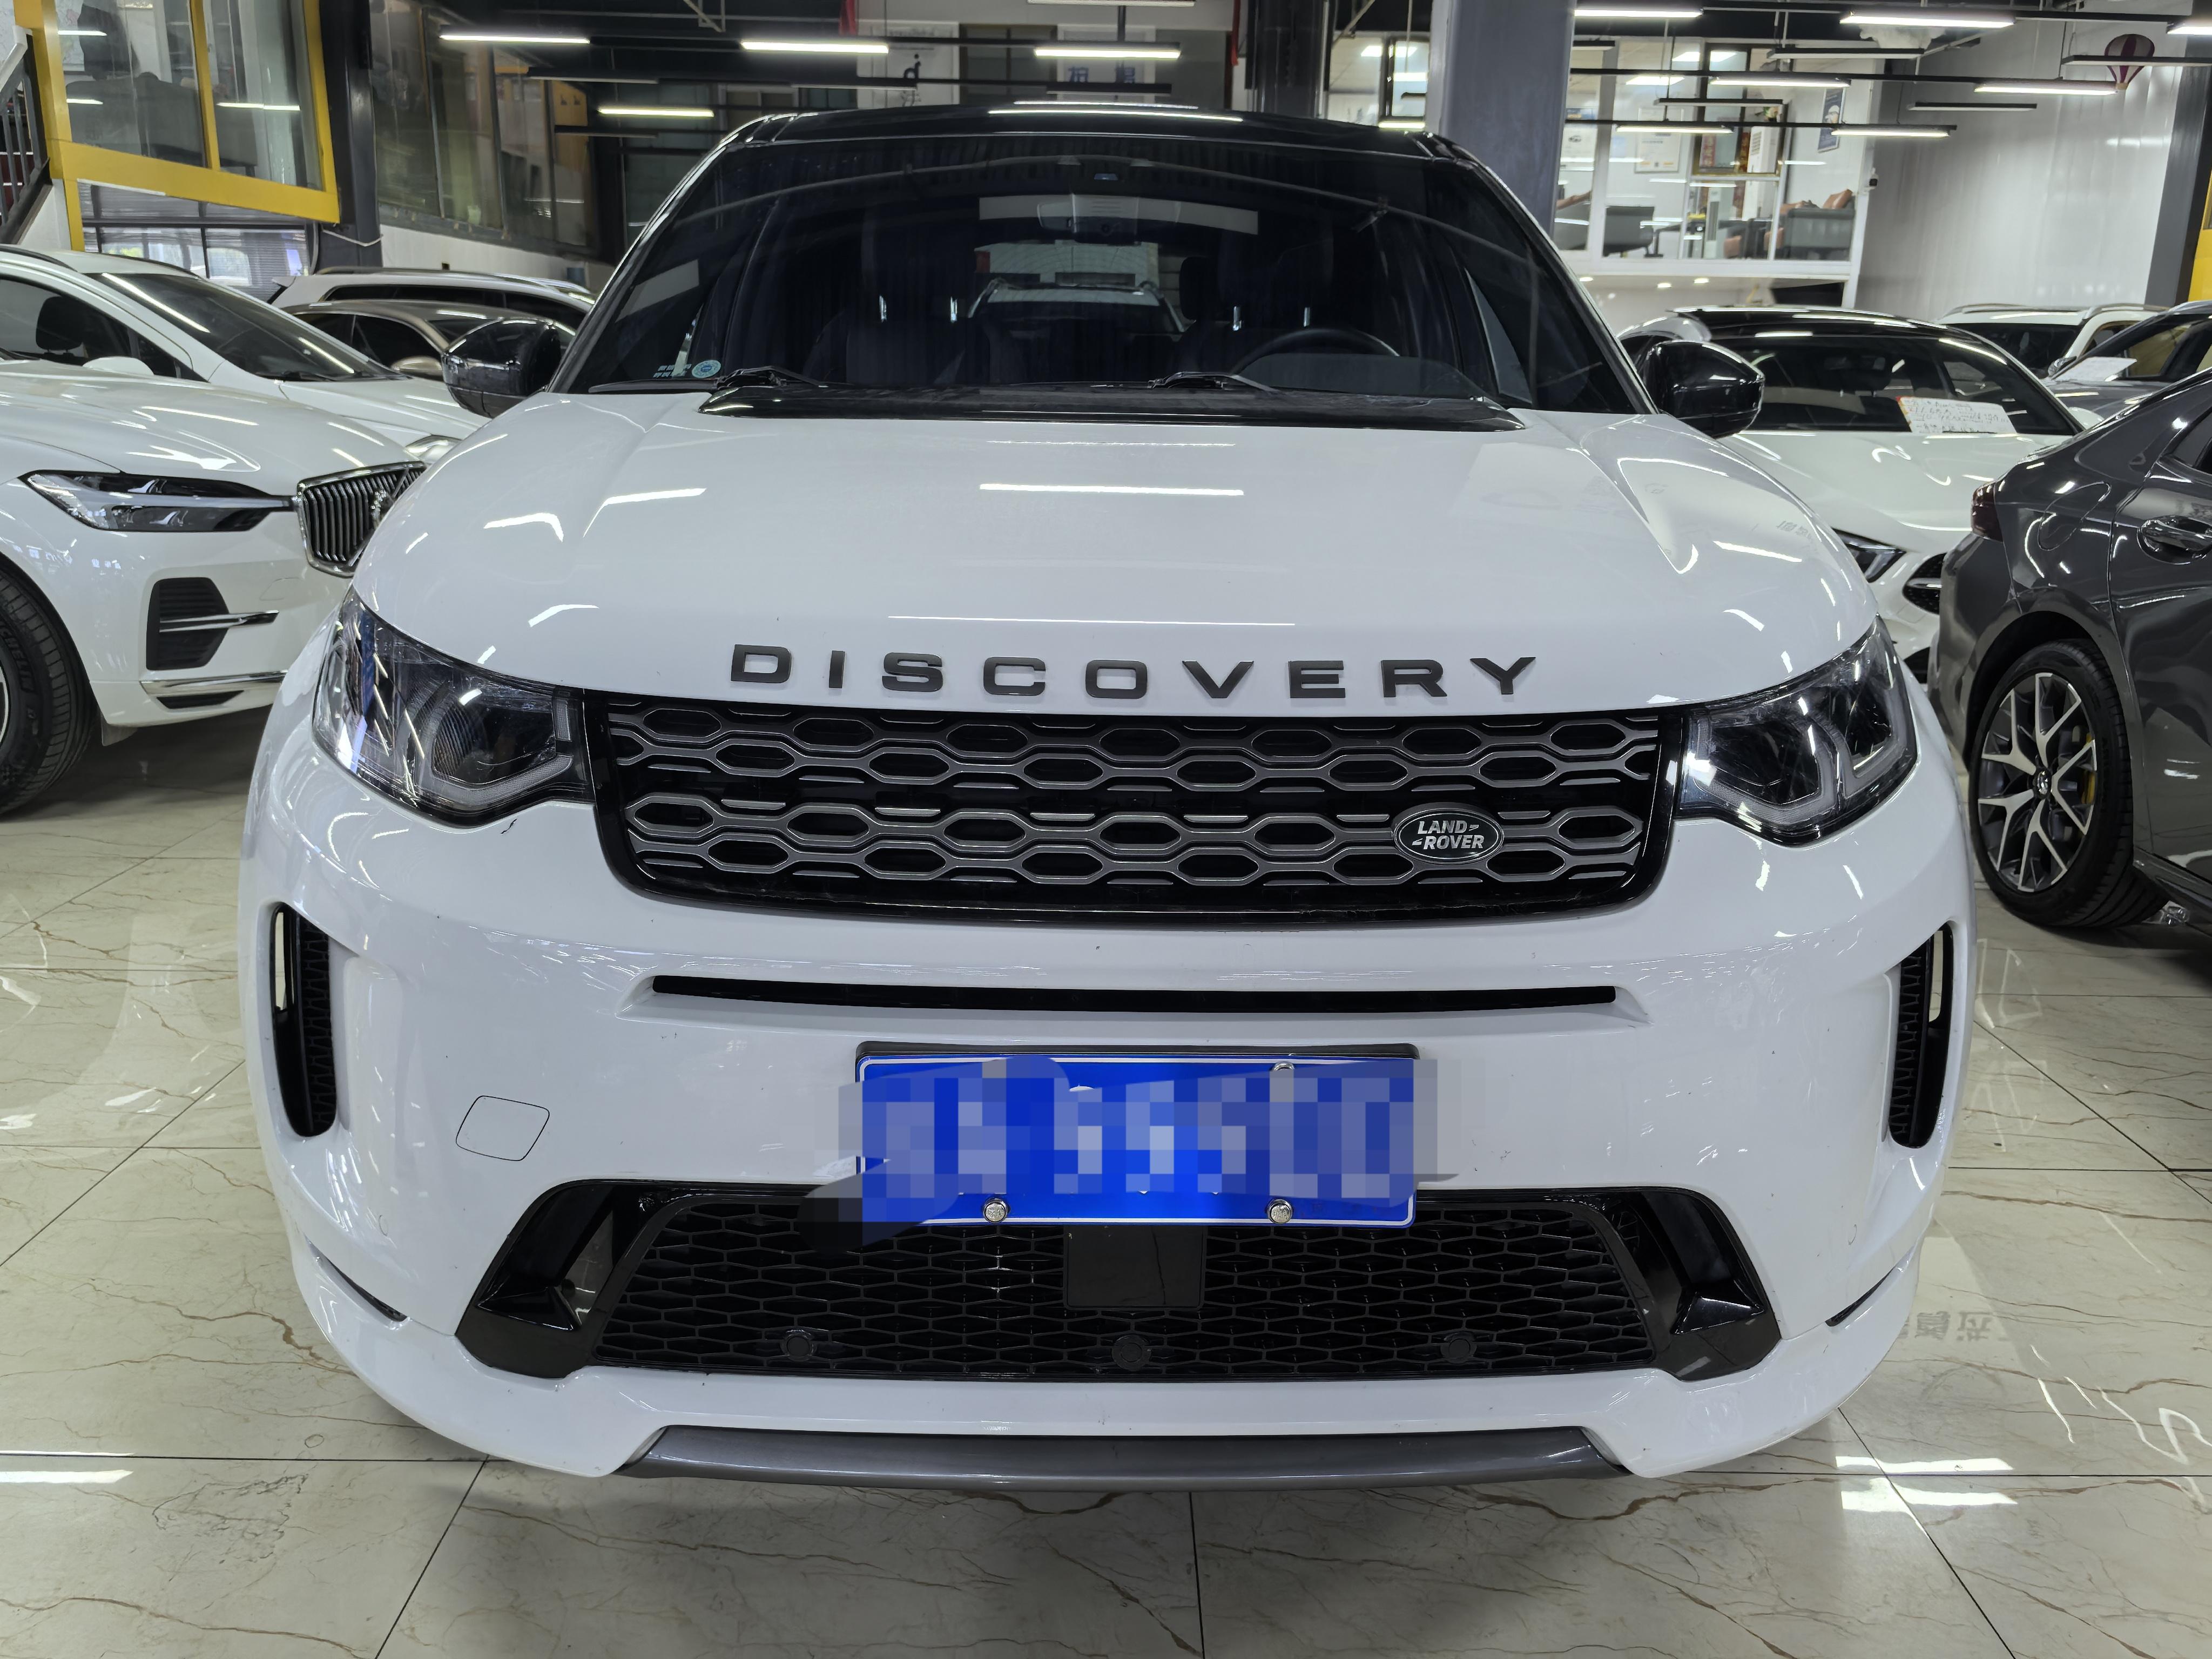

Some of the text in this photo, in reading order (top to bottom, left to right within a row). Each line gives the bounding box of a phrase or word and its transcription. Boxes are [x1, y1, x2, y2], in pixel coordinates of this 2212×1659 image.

[731, 644, 1536, 699] DISCOVERY
[1418, 820, 1467, 834] LAND
[1424, 835, 1484, 849] ROVER
